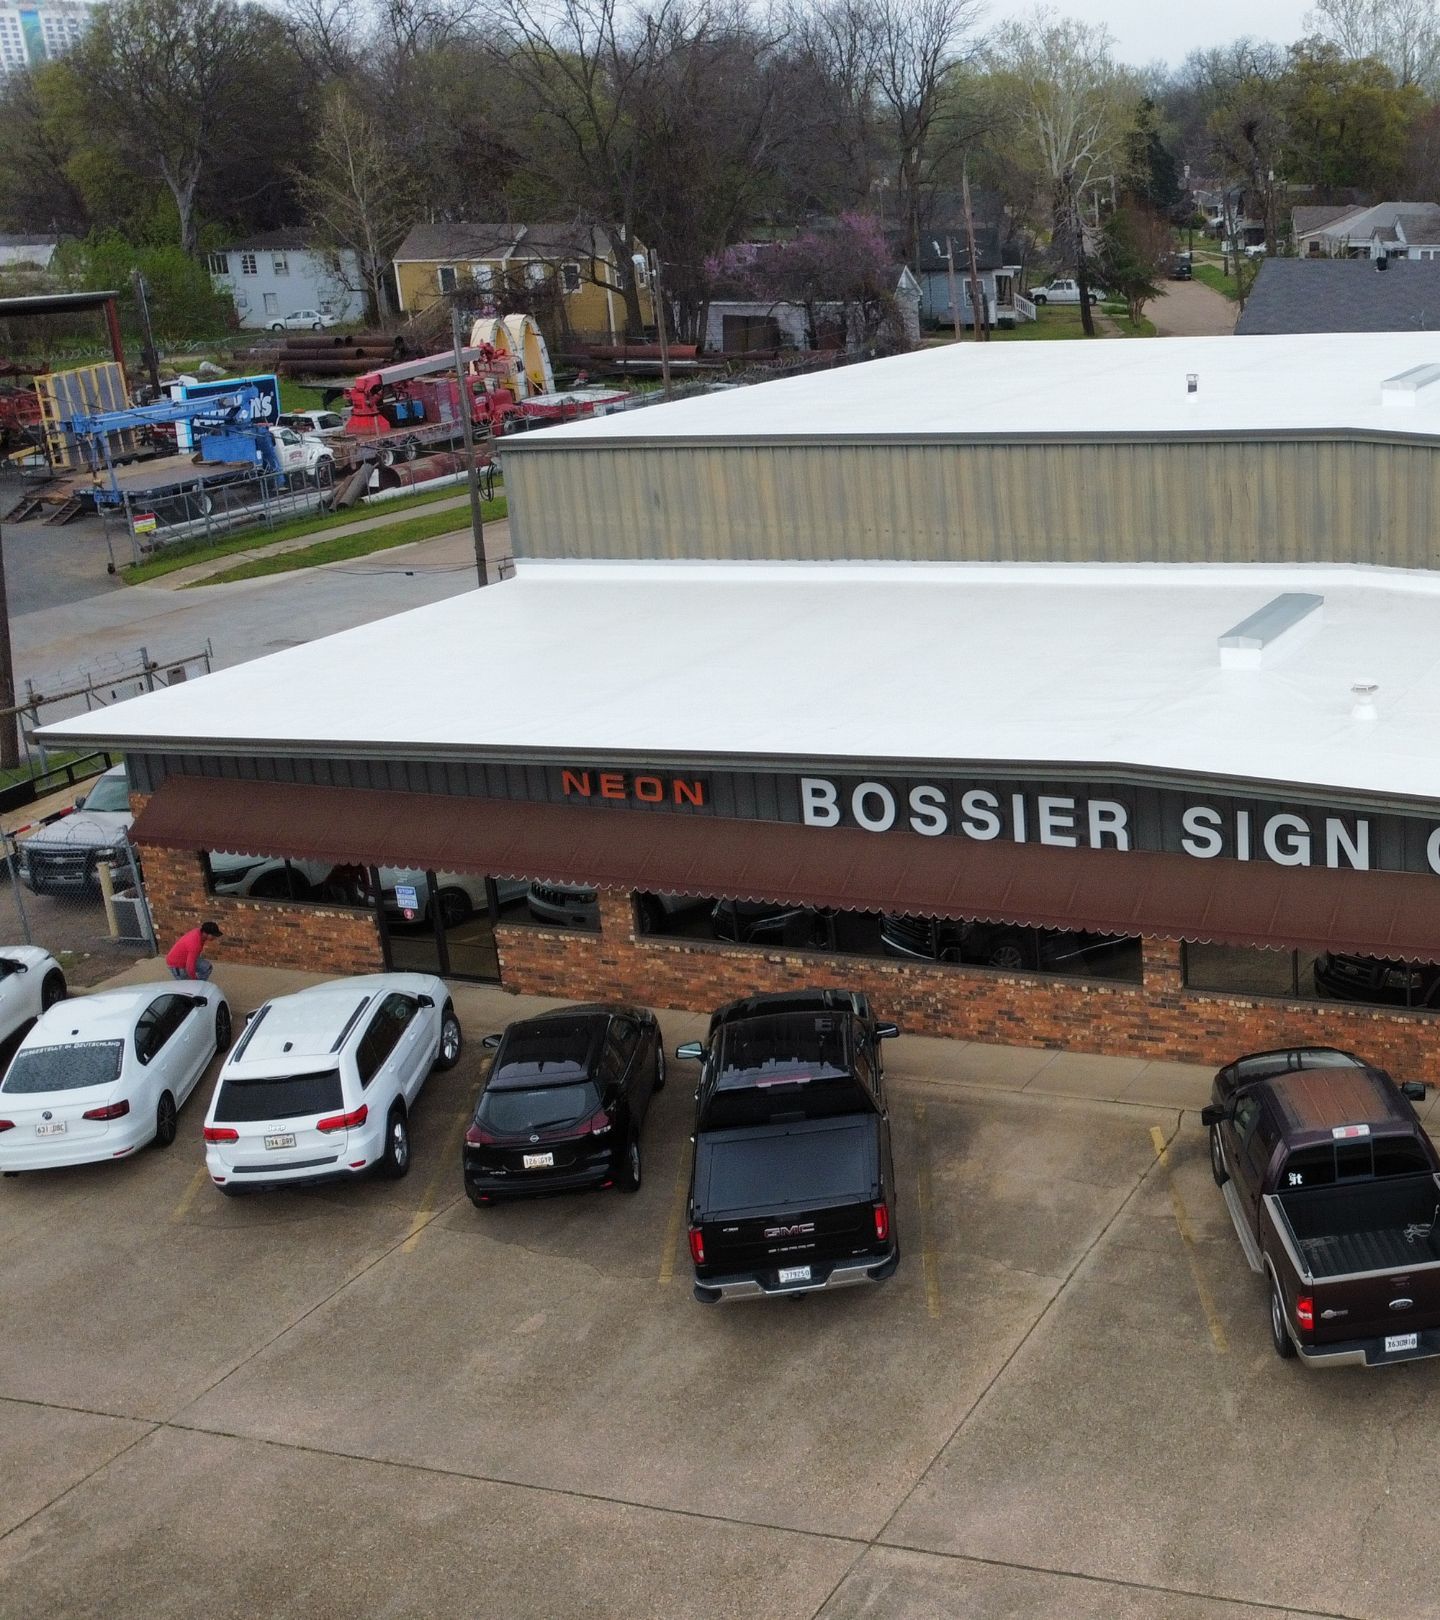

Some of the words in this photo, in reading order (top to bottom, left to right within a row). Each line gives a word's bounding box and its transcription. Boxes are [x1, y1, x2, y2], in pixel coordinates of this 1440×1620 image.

[562, 769, 705, 806] NEON
[801, 777, 1129, 852] BOSSIER
[1182, 806, 1370, 871] SIGN
[764, 1223, 815, 1238] GMC
